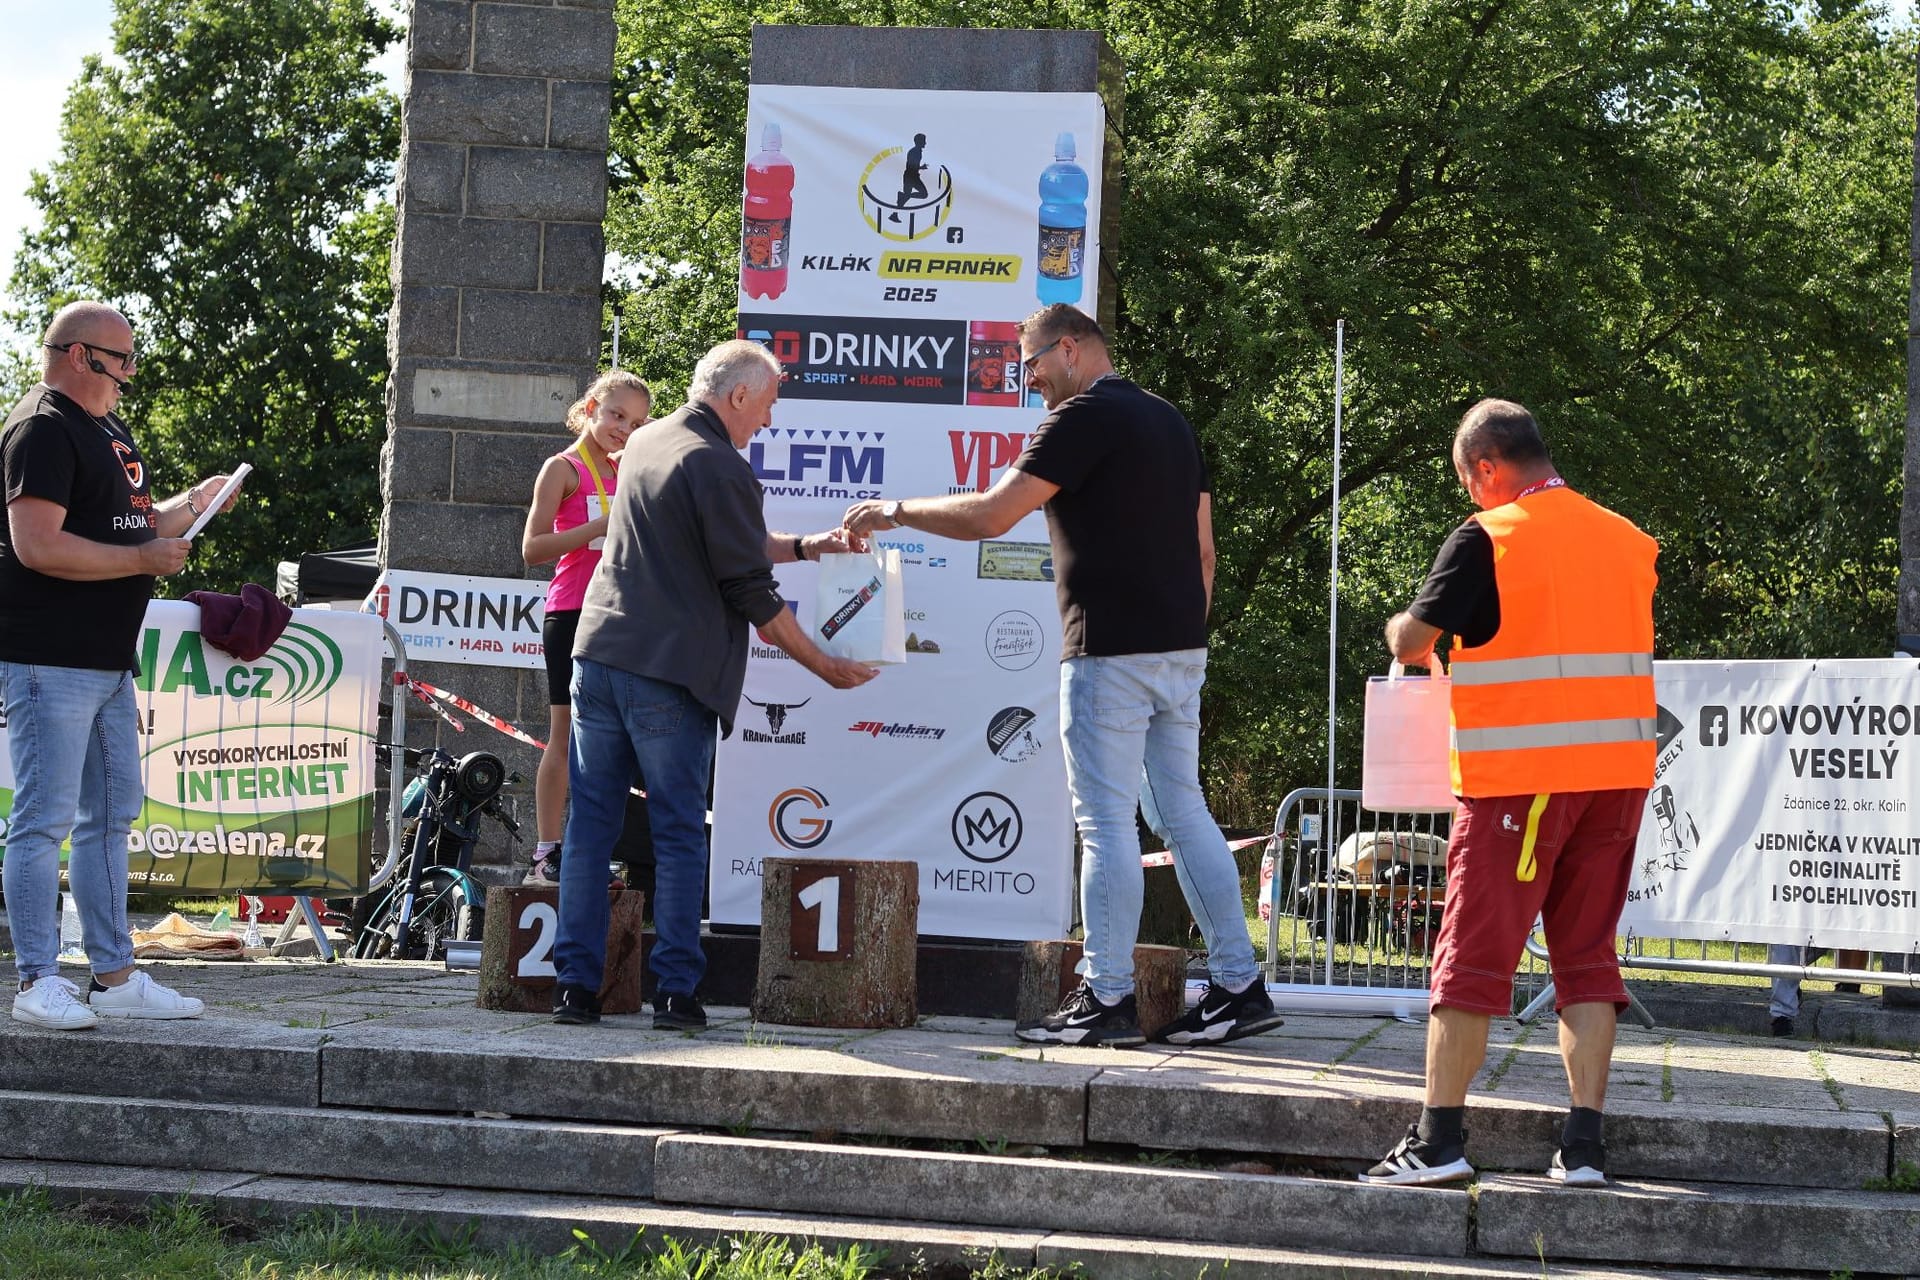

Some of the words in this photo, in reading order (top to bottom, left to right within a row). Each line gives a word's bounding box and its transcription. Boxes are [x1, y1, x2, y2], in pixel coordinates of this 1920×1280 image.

[801, 253, 872, 272] KILÁK
[887, 257, 922, 273] NA
[926, 257, 1013, 276] PANÁK
[883, 286, 938, 302] 2025
[808, 331, 955, 370] DRINKY
[803, 372, 848, 385] SPORT
[859, 374, 897, 387] HARD
[903, 376, 944, 388] WORK
[750, 443, 885, 485] LFM
[398, 586, 548, 634] DRINK
[834, 595, 863, 624] DRINKY
[996, 628, 1034, 637] RESTAURANT
[401, 634, 445, 648] PORT
[460, 638, 504, 652] HARD
[512, 642, 546, 656] WOR
[751, 647, 792, 660] Malotic
[774, 731, 806, 745] GARAGE
[174, 737, 349, 767] VYSOKORYCHLOSTNÍ
[1654, 739, 1685, 780] ESELÝ
[1789, 740, 1899, 780] VESELÝ
[176, 763, 349, 803] INTERNET
[1784, 794, 1830, 811] Ždánice
[1833, 798, 1850, 812] 22,
[1853, 798, 1875, 811] okr.
[1878, 798, 1907, 812] Kolín
[128, 824, 325, 859] o@zelena.cz
[1755, 829, 1842, 853] JEDNIČKA
[1846, 836, 1858, 853] V
[149, 871, 176, 883] s.r.o.
[934, 868, 1035, 894] MERITO
[1789, 858, 1901, 881] ORIGINALITĚ
[1627, 890, 1641, 902] 84
[1644, 882, 1664, 900] 111
[1782, 885, 1917, 909] SPOLEHLIVOSTI
[798, 876, 840, 953] 1
[517, 902, 558, 977] 2
